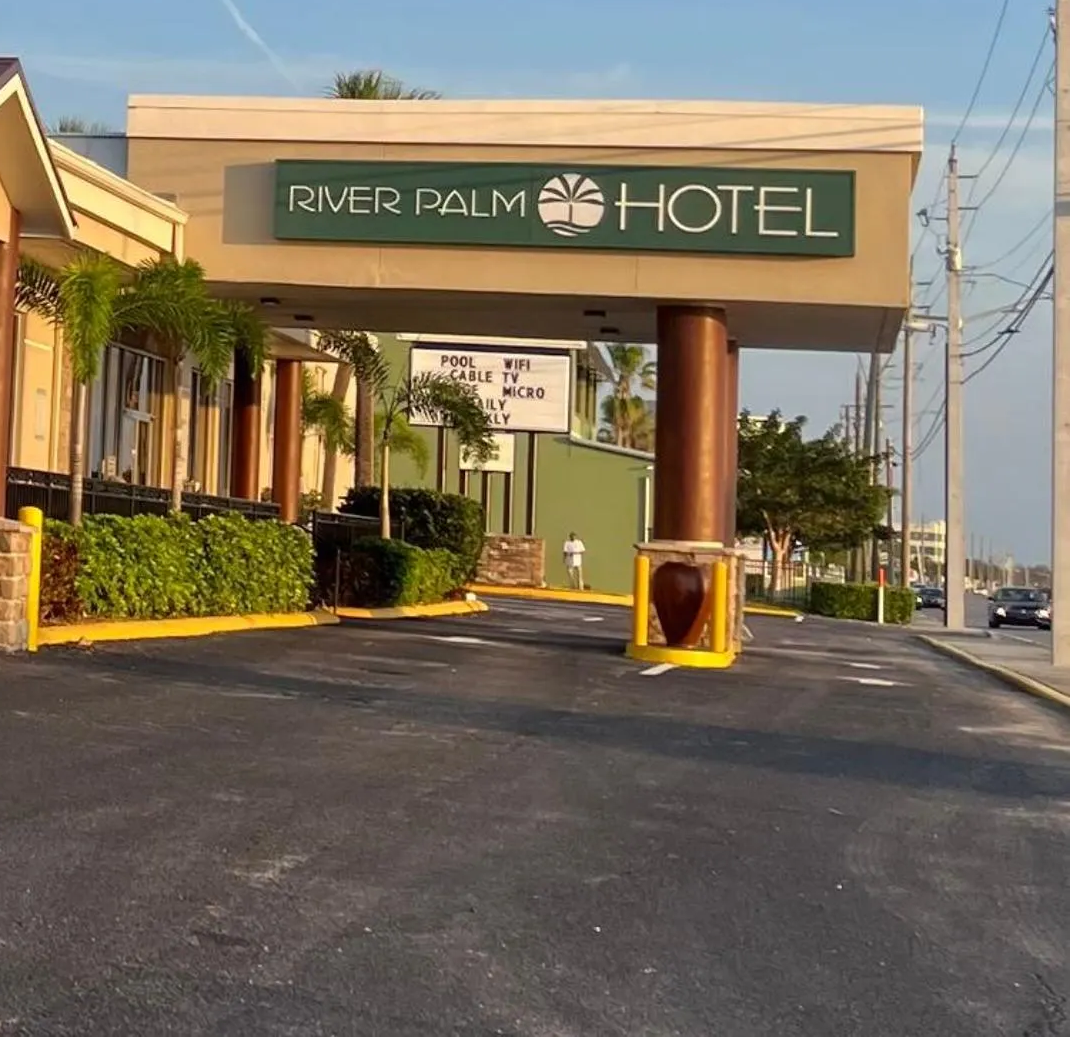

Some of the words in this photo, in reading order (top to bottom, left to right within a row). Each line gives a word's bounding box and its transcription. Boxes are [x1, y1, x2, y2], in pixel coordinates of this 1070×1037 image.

[289, 185, 401, 214] RIVER
[415, 188, 526, 217] PALM
[614, 182, 839, 237] HOTEL
[441, 355, 476, 368] POOL
[503, 358, 530, 371] WIFI
[450, 369, 493, 383] CABLE
[503, 372, 519, 384] TV
[503, 386, 545, 399] MICRO
[470, 397, 507, 411] AILY
